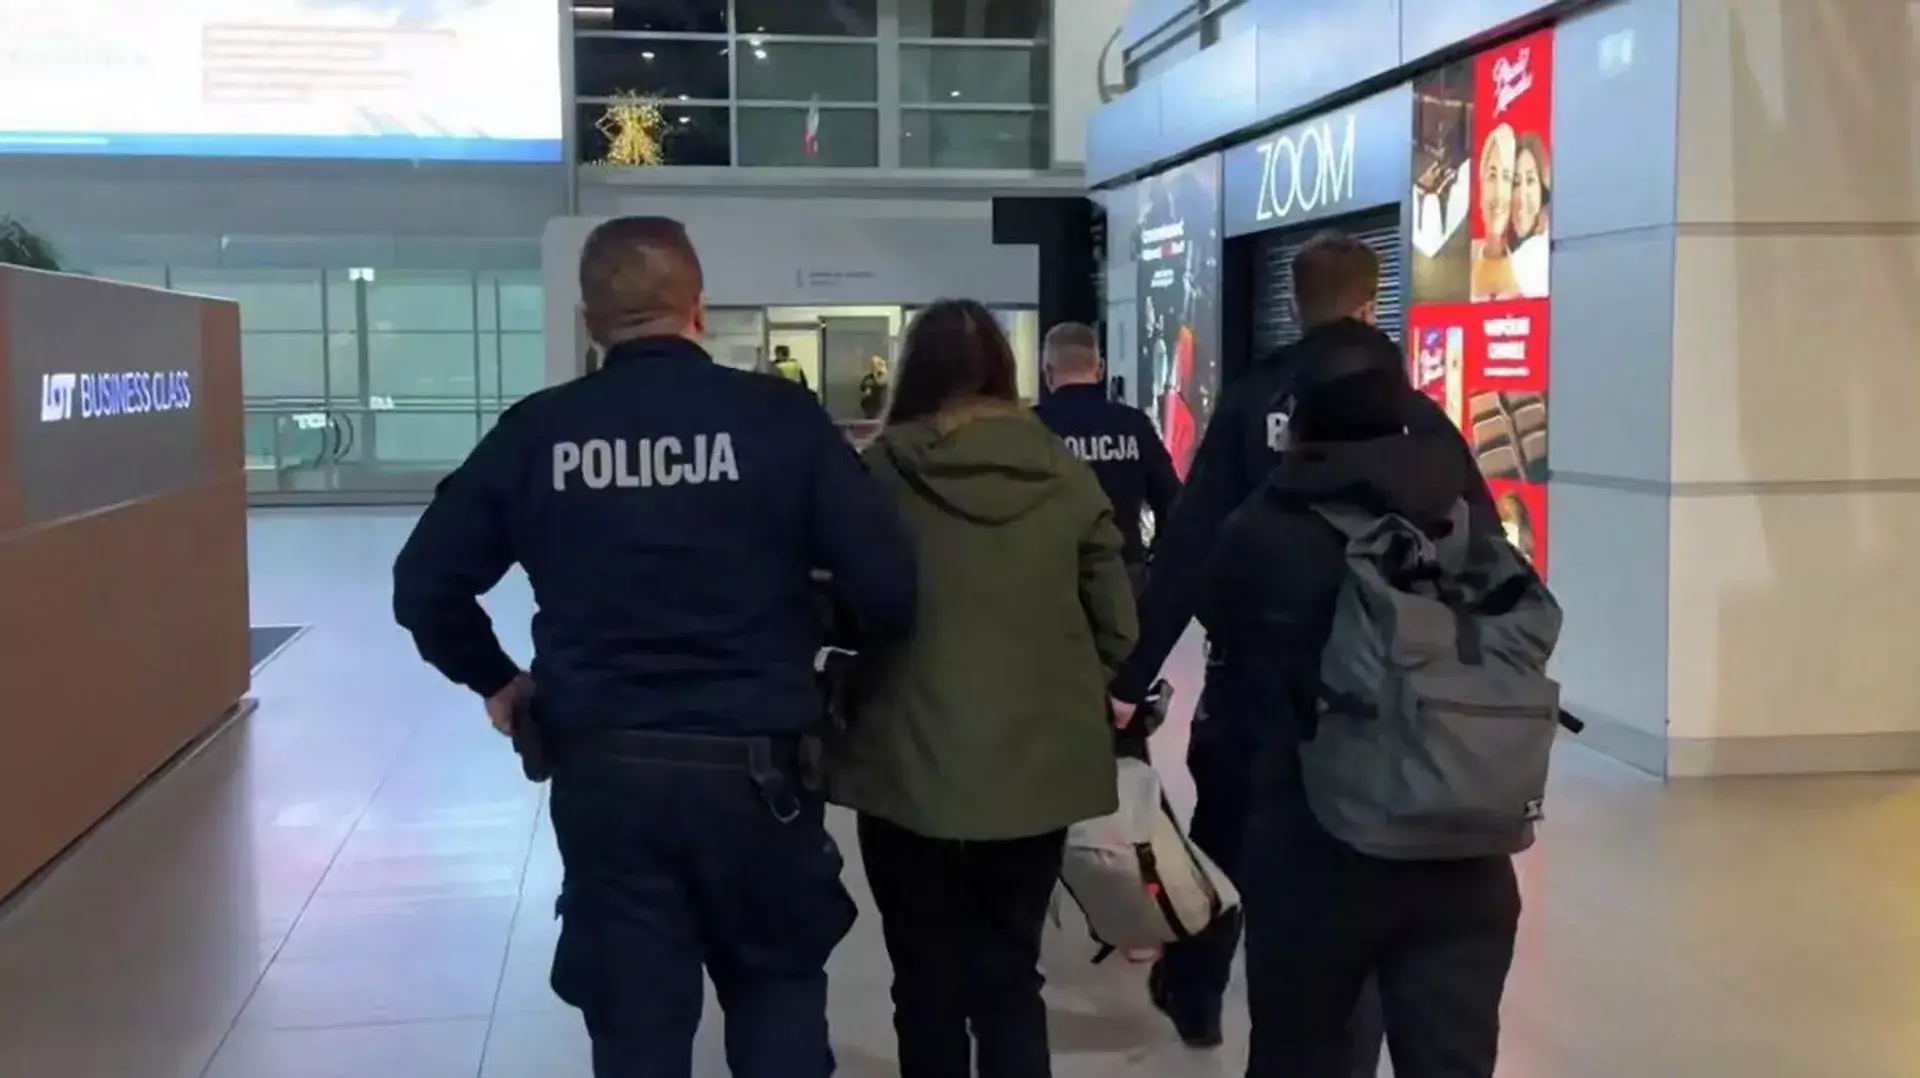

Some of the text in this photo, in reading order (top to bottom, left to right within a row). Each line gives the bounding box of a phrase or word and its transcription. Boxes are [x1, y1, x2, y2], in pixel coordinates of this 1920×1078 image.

[1256, 115, 1355, 220] ZOOM
[41, 371, 191, 422] LOT BUSINESS CLASS
[553, 432, 739, 491] POLICJA
[1064, 434, 1140, 461] OLICJA
